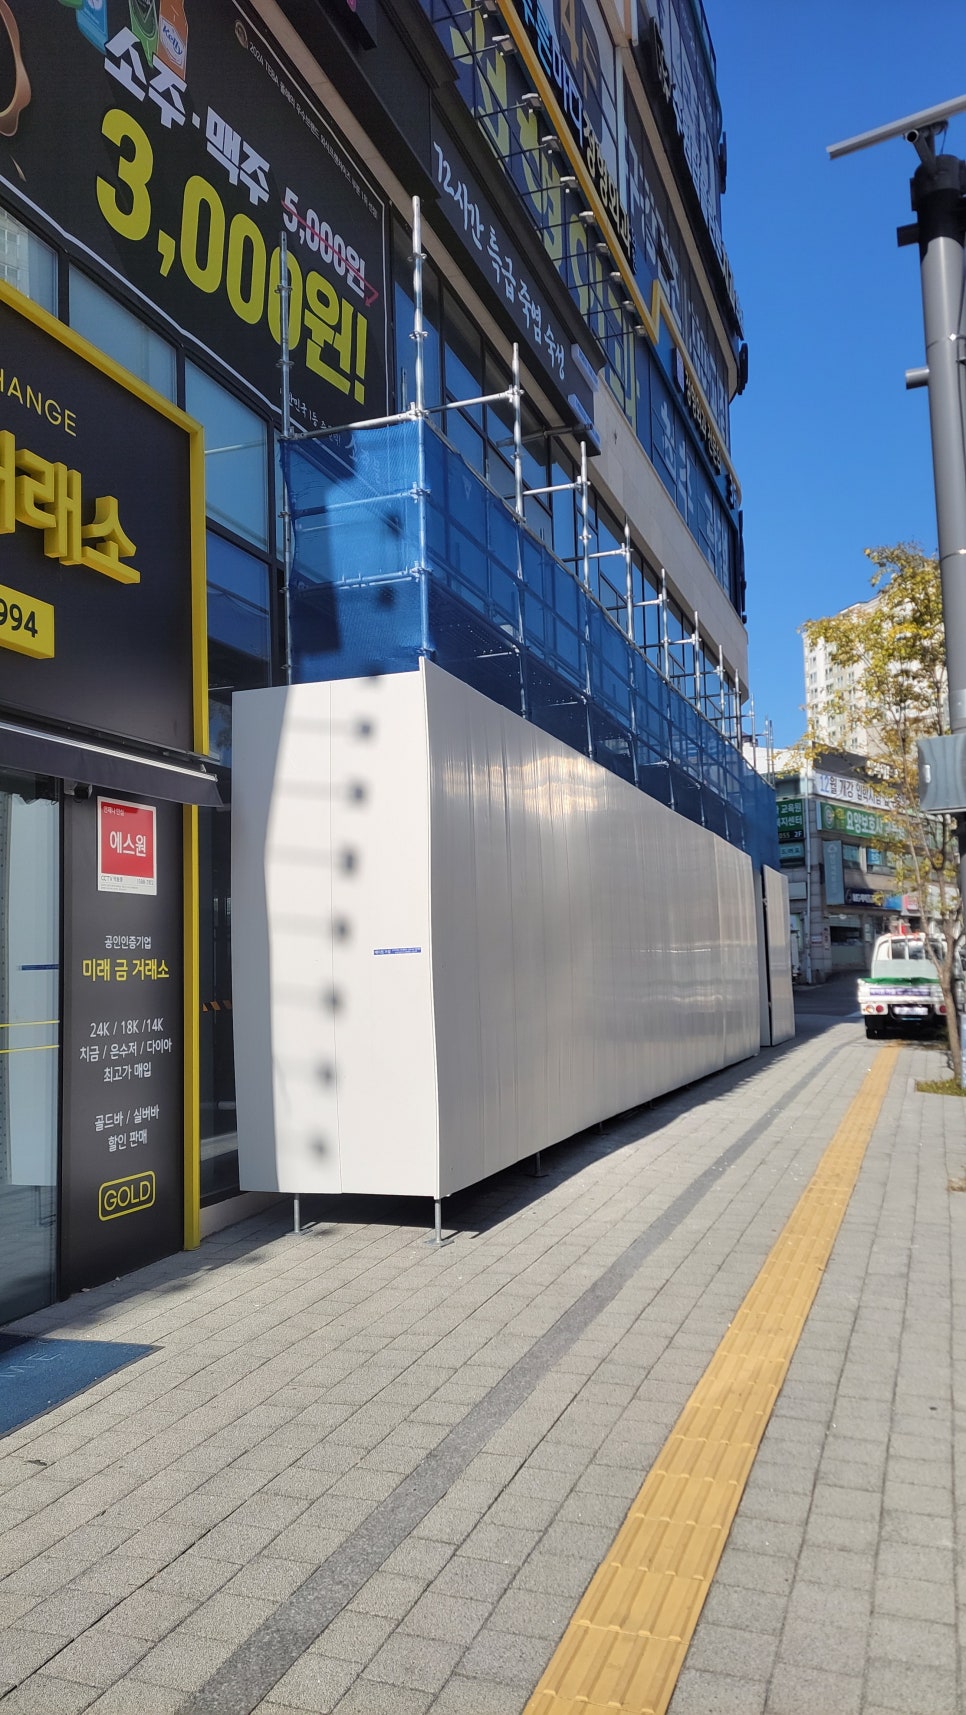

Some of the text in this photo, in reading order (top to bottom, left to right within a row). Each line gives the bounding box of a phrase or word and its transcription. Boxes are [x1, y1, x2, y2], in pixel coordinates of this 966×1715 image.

[162, 25, 183, 56] Kelly
[249, 41, 264, 66] 2024
[282, 187, 366, 298] 5,000원
[97, 108, 368, 405] 3,000원!
[433, 141, 565, 380] 72시간 특급 죽염 숙성
[846, 810, 883, 836] 요양보호사
[109, 830, 147, 858] 에스원
[104, 935, 152, 950] 공인인증기업
[82, 958, 170, 982] 미래 금 거래소
[90, 1021, 110, 1038] 24K
[121, 1019, 140, 1035] 18K
[80, 1046, 100, 1063] 치금
[110, 1041, 137, 1060] 은수저
[146, 1037, 173, 1055] 다이아
[104, 1061, 152, 1083] 최고가 매입
[95, 1111, 124, 1132] 골드바
[133, 1104, 160, 1125] 실버바
[108, 1128, 148, 1153] 할인 판매
[103, 1180, 151, 1212] GOLD
